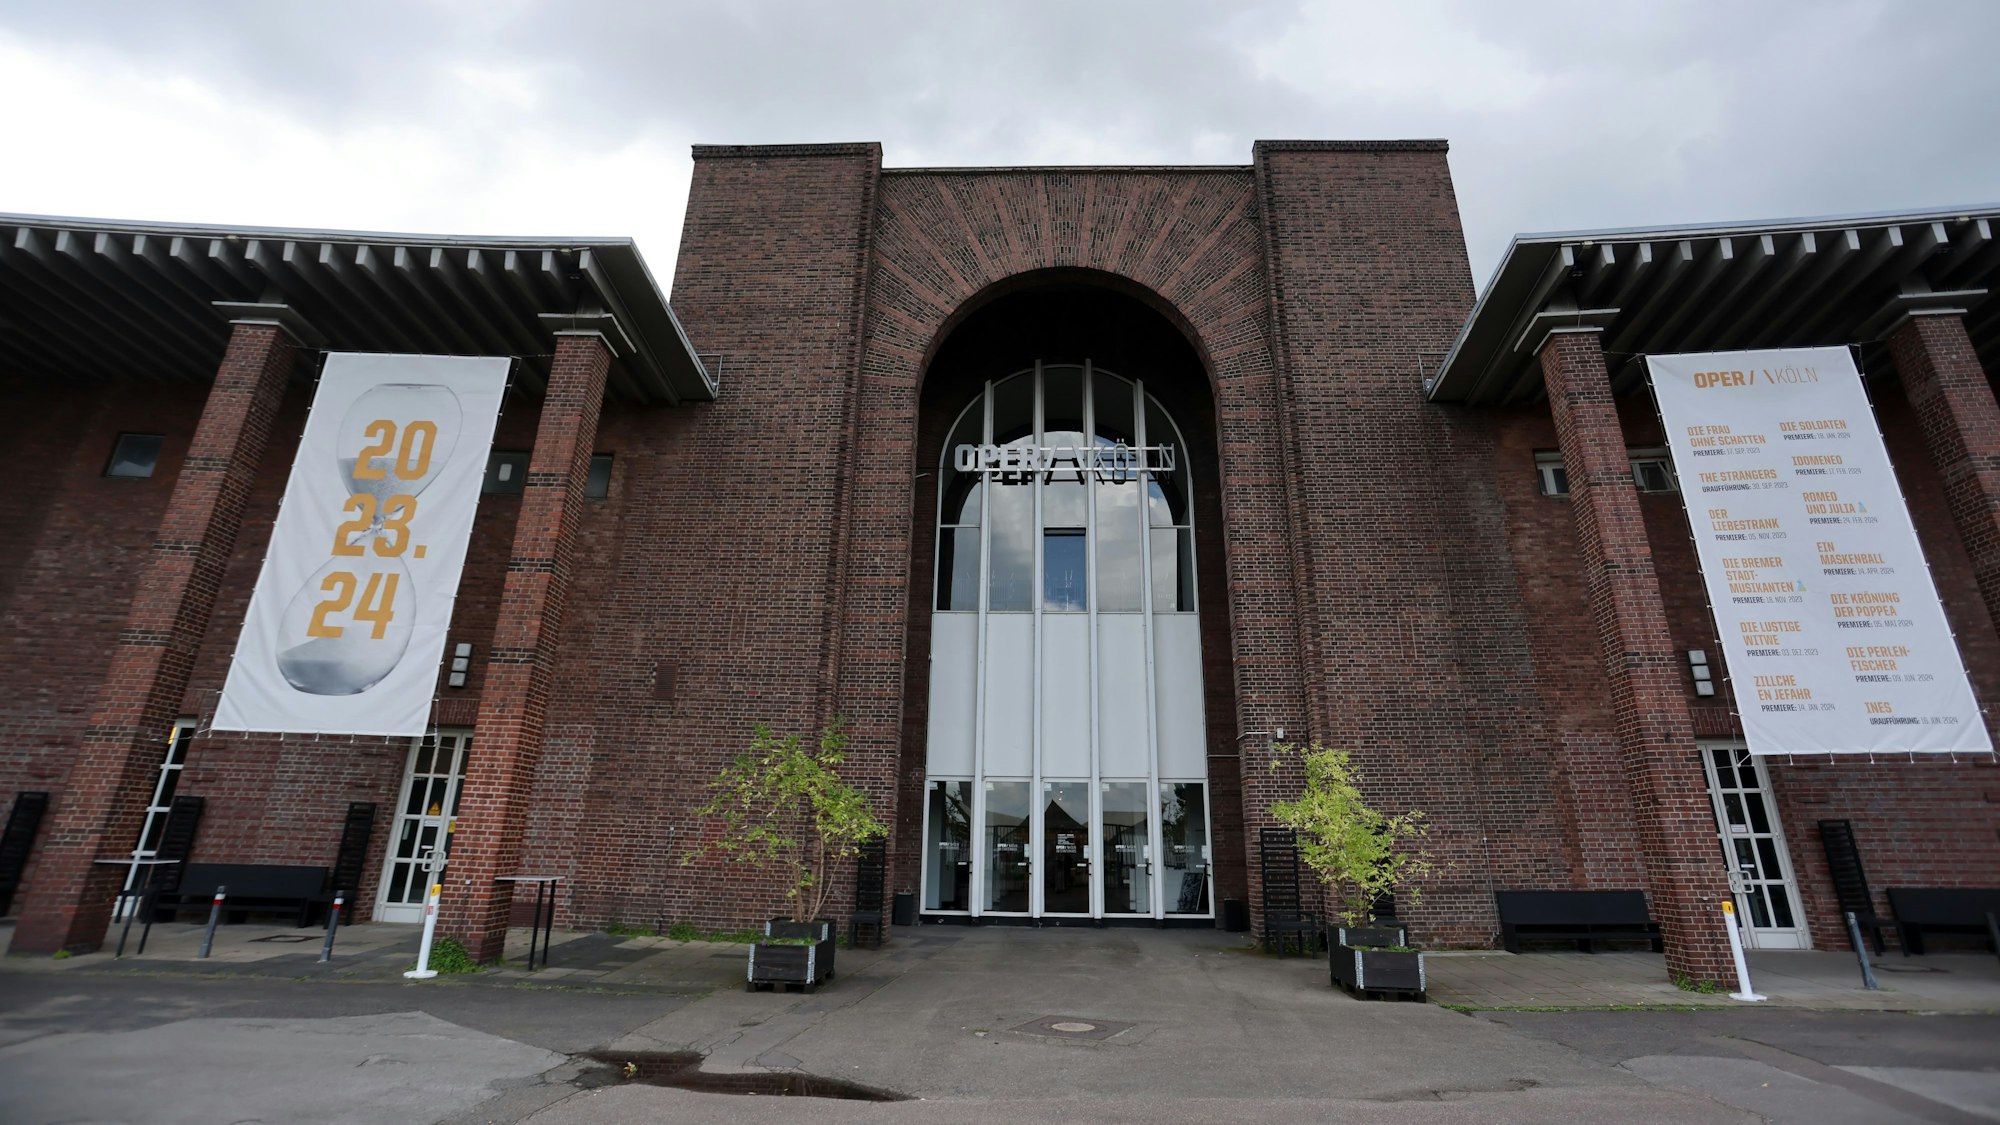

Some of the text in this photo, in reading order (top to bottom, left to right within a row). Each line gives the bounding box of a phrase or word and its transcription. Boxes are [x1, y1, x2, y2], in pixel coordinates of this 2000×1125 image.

[1687, 425, 1730, 436] DIE FRAU
[1780, 420, 1847, 432] DIE SOLDATEN
[1690, 435, 1766, 447] OHNE SCHATTEN
[352, 419, 438, 480] 20
[1792, 455, 1843, 466] IDOMENEO
[1699, 469, 1777, 483] THE STRANGERS
[1803, 491, 1838, 502] ROMEO
[1709, 510, 1728, 519] DER
[1806, 503, 1855, 514] UND JULIA
[332, 493, 427, 559] 23.
[1712, 519, 1780, 531] LIEBESTRANK
[1817, 542, 1835, 552] EIN
[1722, 557, 1783, 569] DIE BREMER
[1820, 554, 1884, 565] MASKENBALL
[1726, 570, 1758, 581] STADT-
[1729, 582, 1794, 594] MUSIKANTEN
[1830, 590, 1900, 604] DIE KRÖNUNG
[306, 571, 400, 640] 24
[1834, 606, 1897, 618] DER POPPEA
[1740, 621, 1801, 632] DIE LUSTIGE
[1743, 635, 1780, 646] WITWE
[1846, 646, 1910, 658] DIE PERLEN-
[1850, 659, 1897, 671] FISCHER
[1754, 675, 1796, 687] ZILLCHE
[1758, 688, 1812, 701] EN JEFAHR
[1865, 702, 1893, 714] INES
